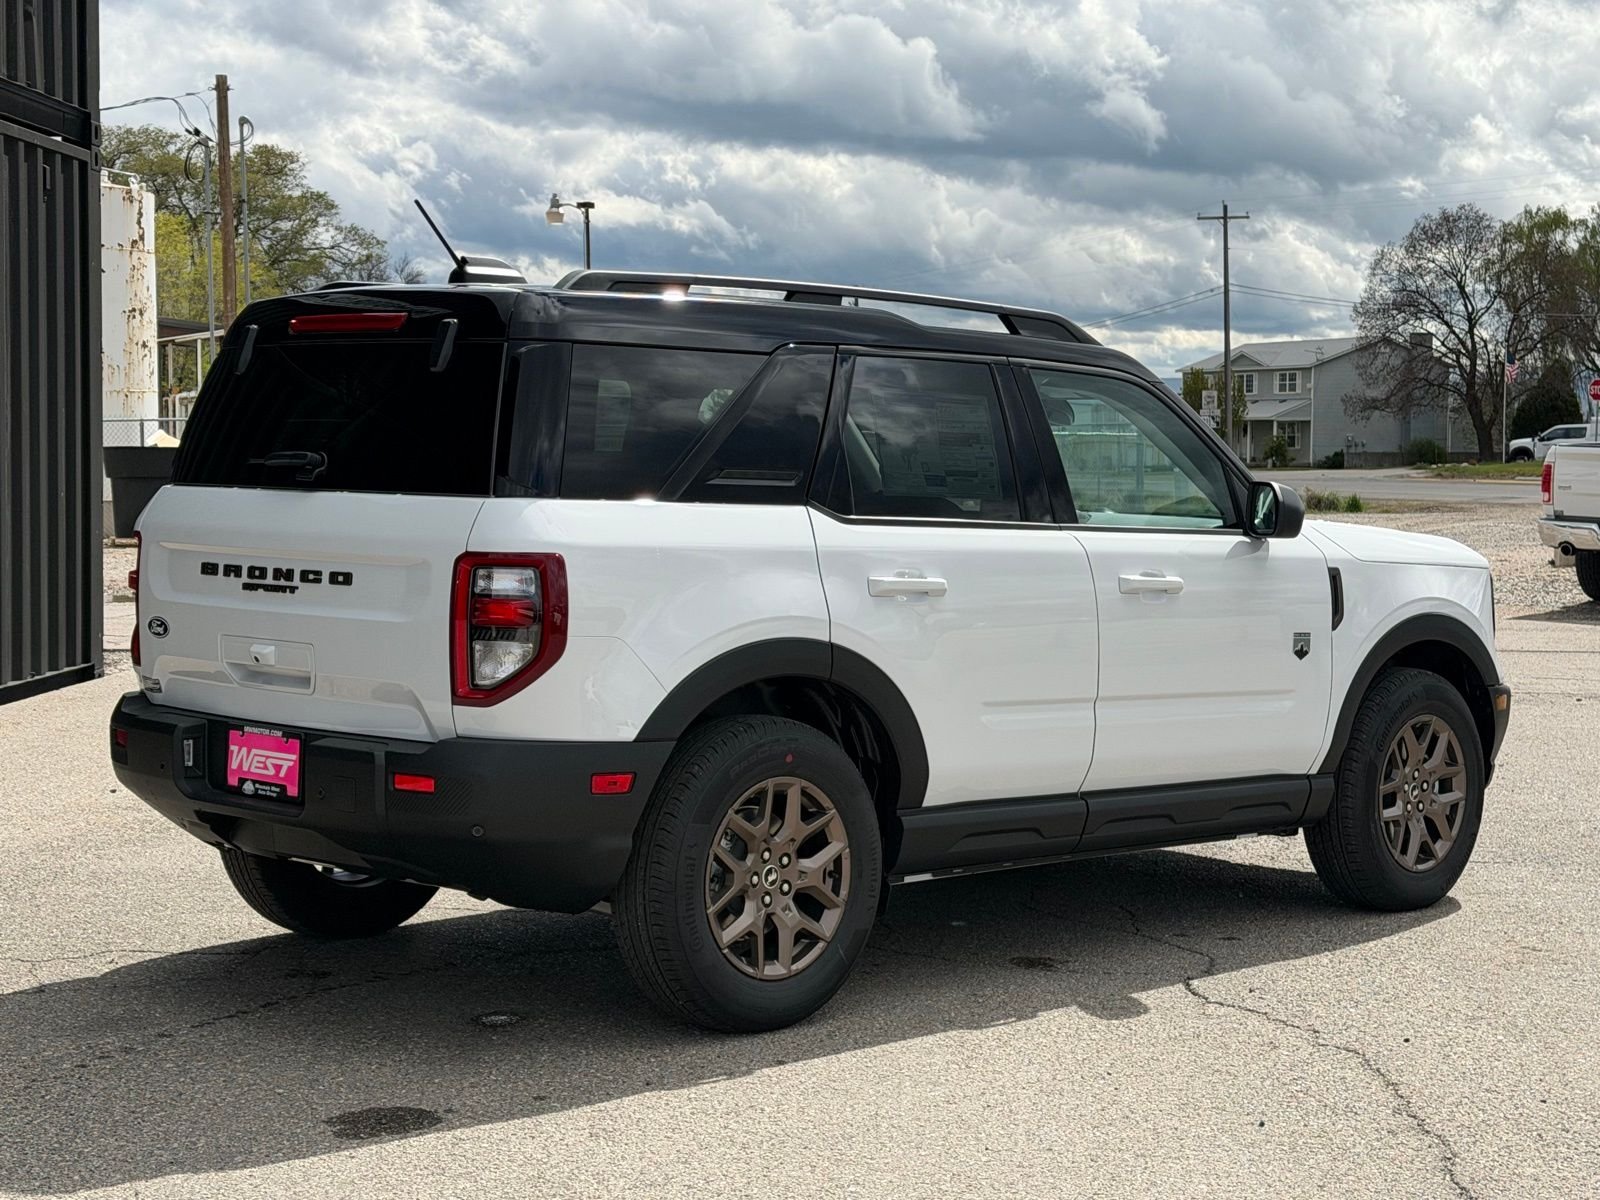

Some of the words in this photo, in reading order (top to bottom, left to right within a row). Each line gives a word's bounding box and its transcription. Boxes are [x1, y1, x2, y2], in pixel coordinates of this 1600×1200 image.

[201, 562, 353, 586] BRONCO
[242, 582, 299, 594] SPORT
[229, 745, 297, 777] WEST
